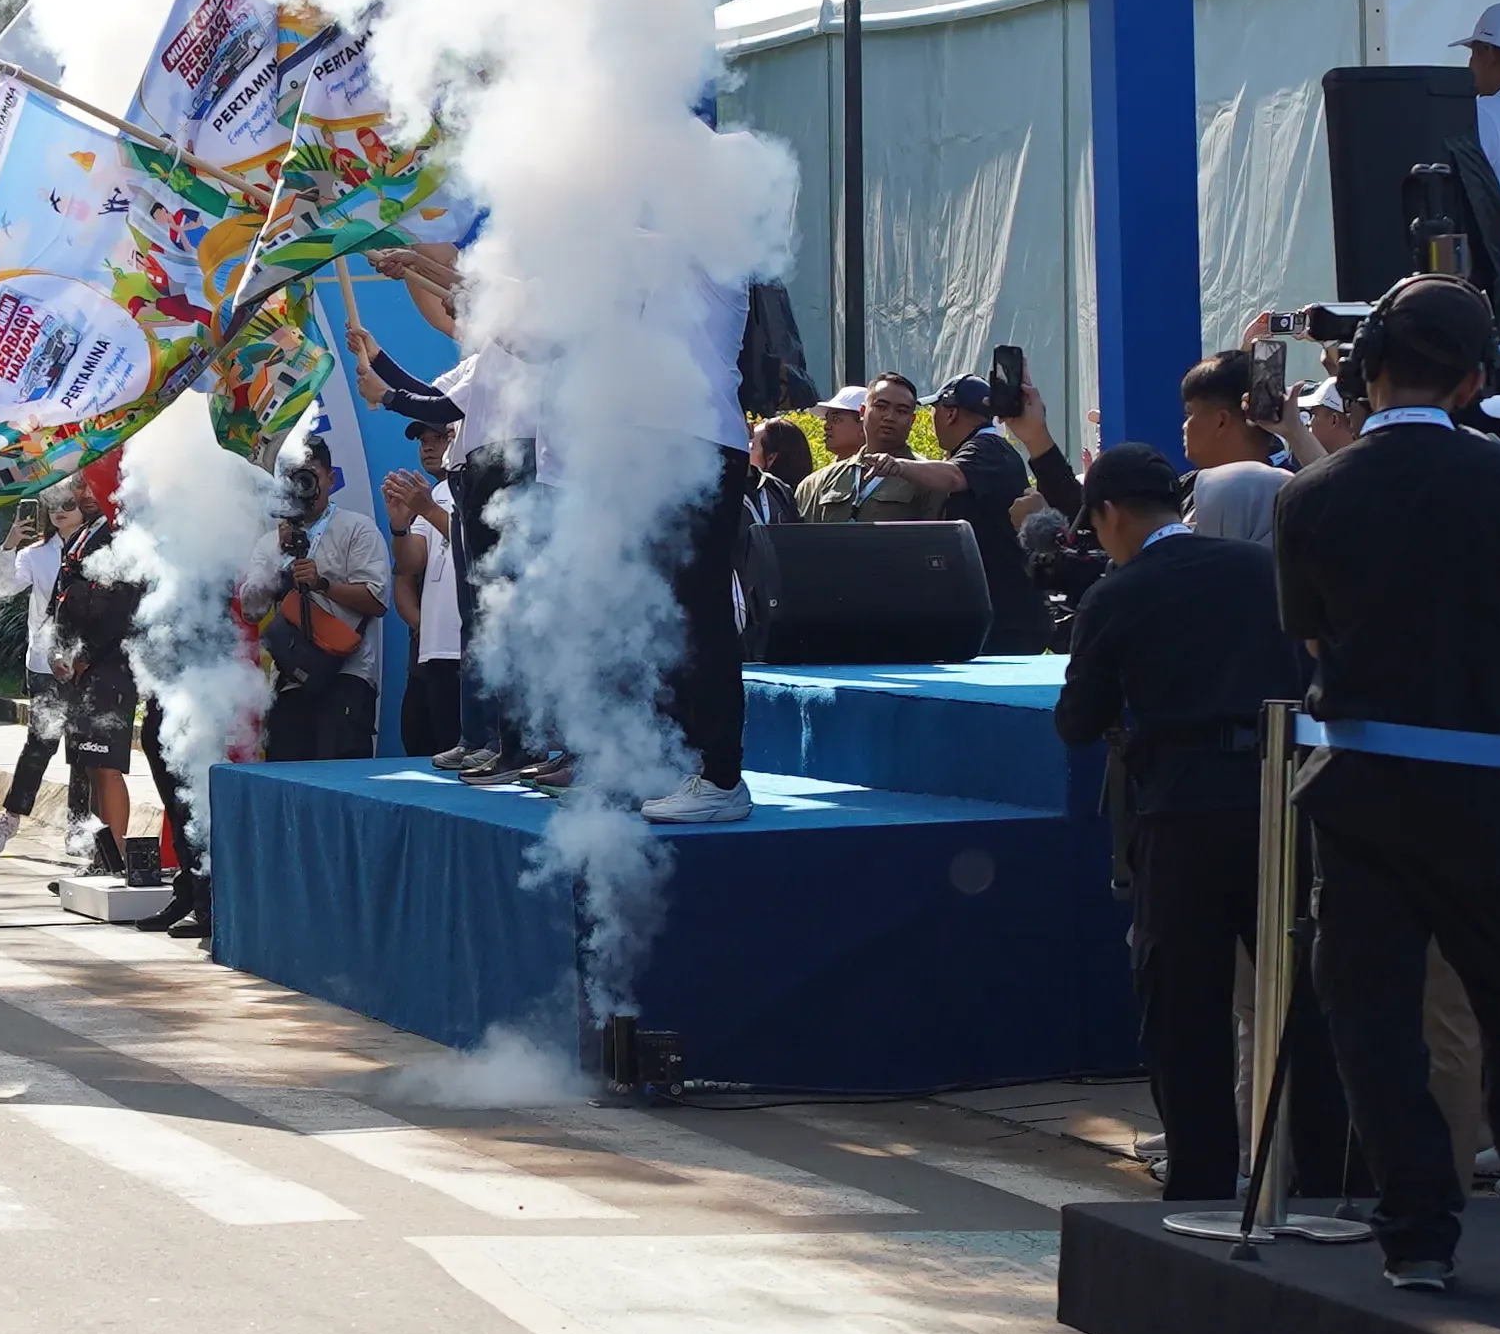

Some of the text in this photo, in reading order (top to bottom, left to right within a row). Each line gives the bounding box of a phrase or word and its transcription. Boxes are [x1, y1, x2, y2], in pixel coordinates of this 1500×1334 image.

[166, 19, 202, 67] MUDIK
[177, 6, 228, 79] BERBAGI
[186, 18, 232, 90] HARAPAN
[5, 320, 41, 384] HARAPAN
[60, 339, 112, 409] PERTAMINA
